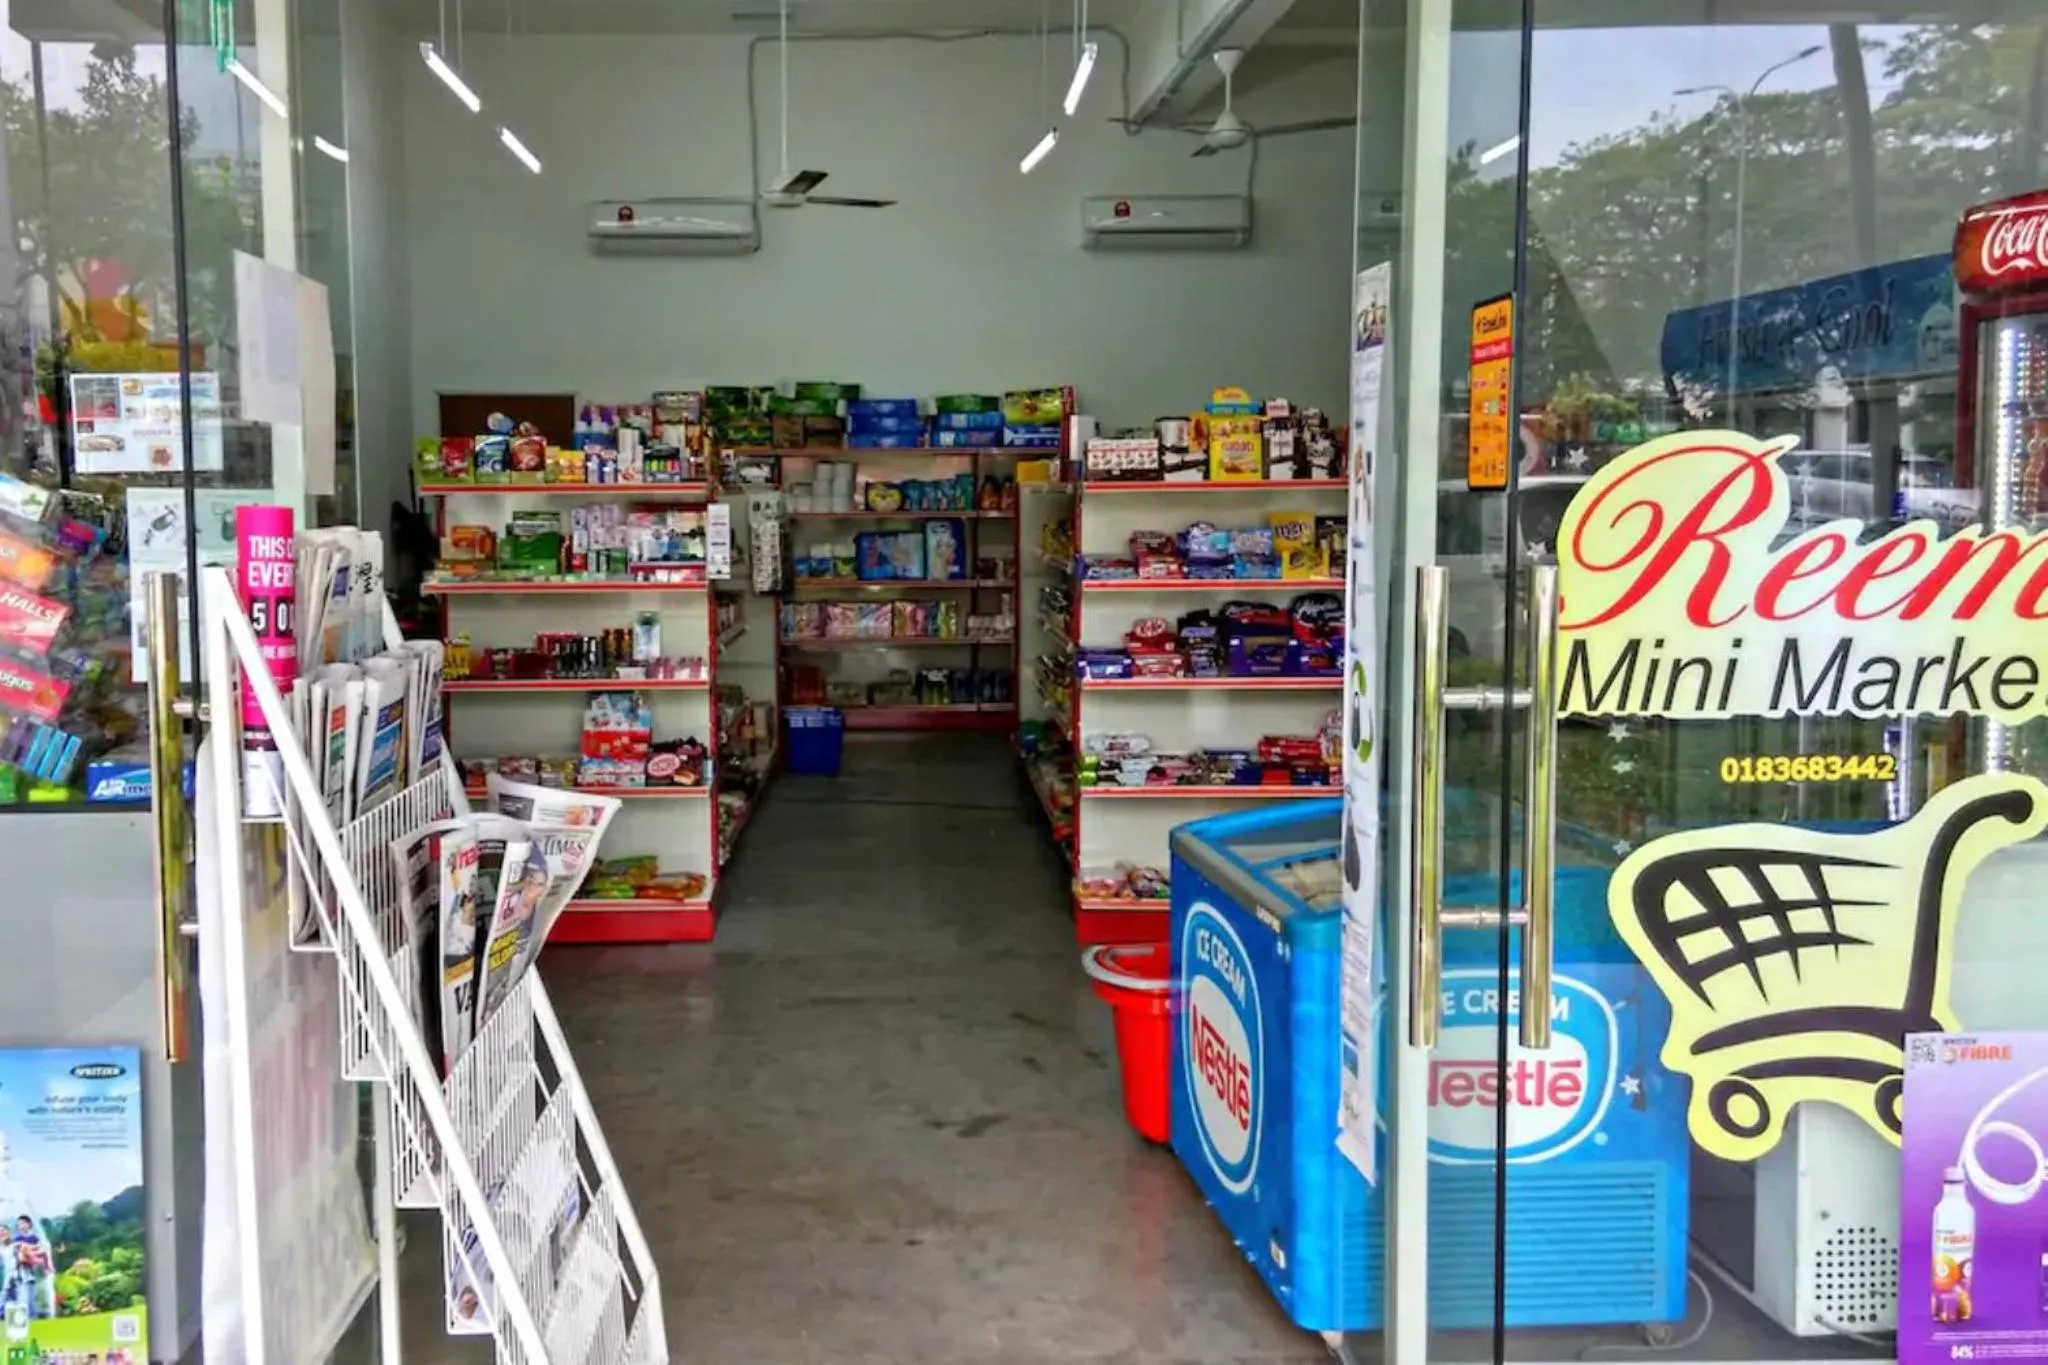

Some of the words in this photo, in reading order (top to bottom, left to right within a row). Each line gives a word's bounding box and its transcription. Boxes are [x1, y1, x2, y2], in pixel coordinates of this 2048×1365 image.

[248, 536, 284, 558] THIS
[1, 591, 57, 621] HALLS
[1558, 637, 1745, 713] Mini
[1768, 636, 2048, 713] Marke
[1720, 754, 1898, 784] 0183683442
[1195, 926, 1211, 962] ICE
[1211, 933, 1246, 1009] CREAM
[1463, 988, 1570, 1021] CREM
[1191, 1002, 1250, 1132] Nestlé
